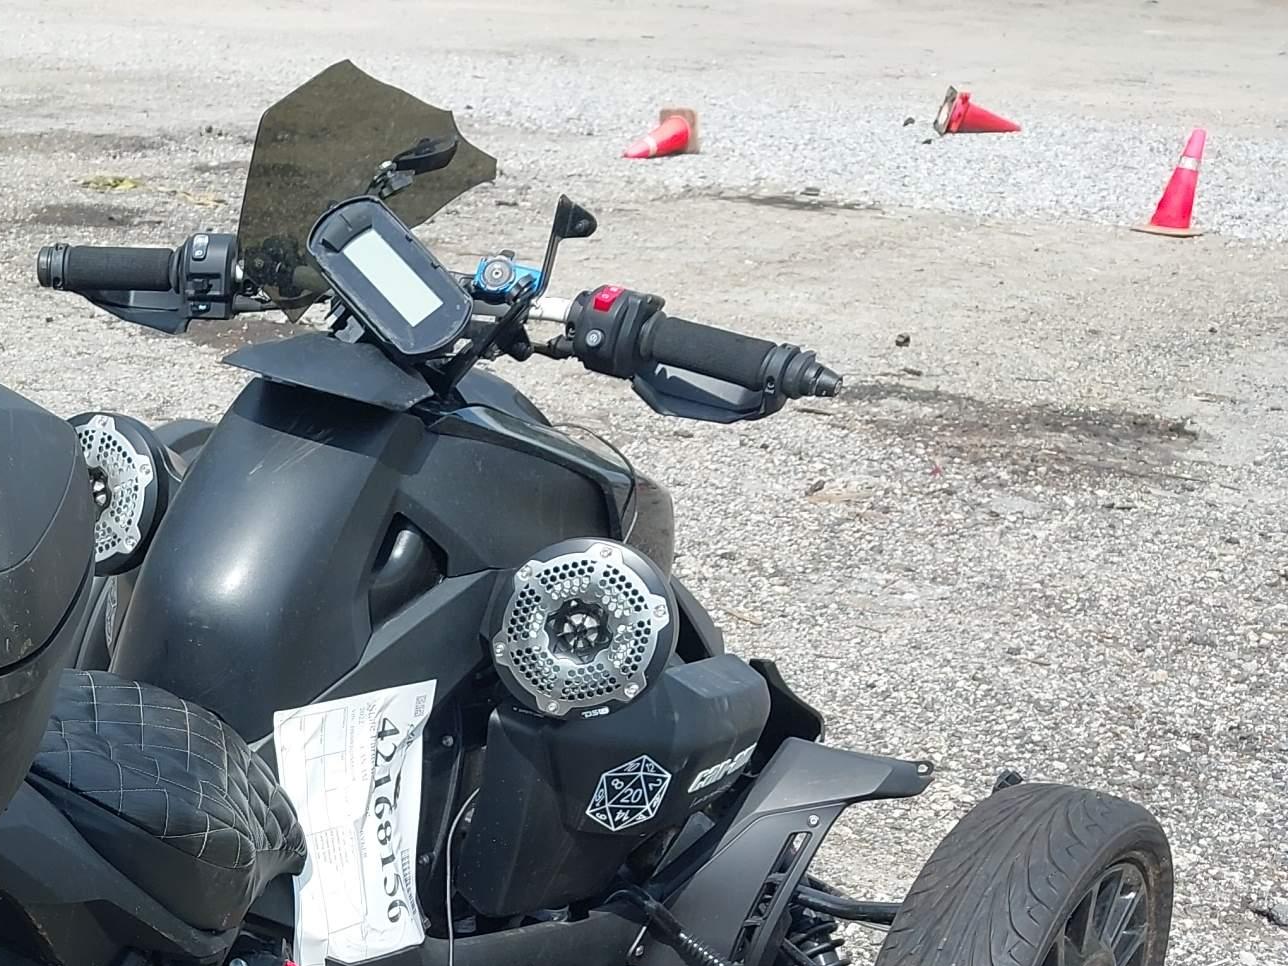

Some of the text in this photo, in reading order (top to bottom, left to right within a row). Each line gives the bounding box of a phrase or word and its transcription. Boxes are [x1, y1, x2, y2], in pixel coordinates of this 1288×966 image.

[645, 763, 656, 773] 12
[611, 778, 624, 790] 8
[620, 788, 643, 803] 20
[373, 717, 409, 924] 42168156
